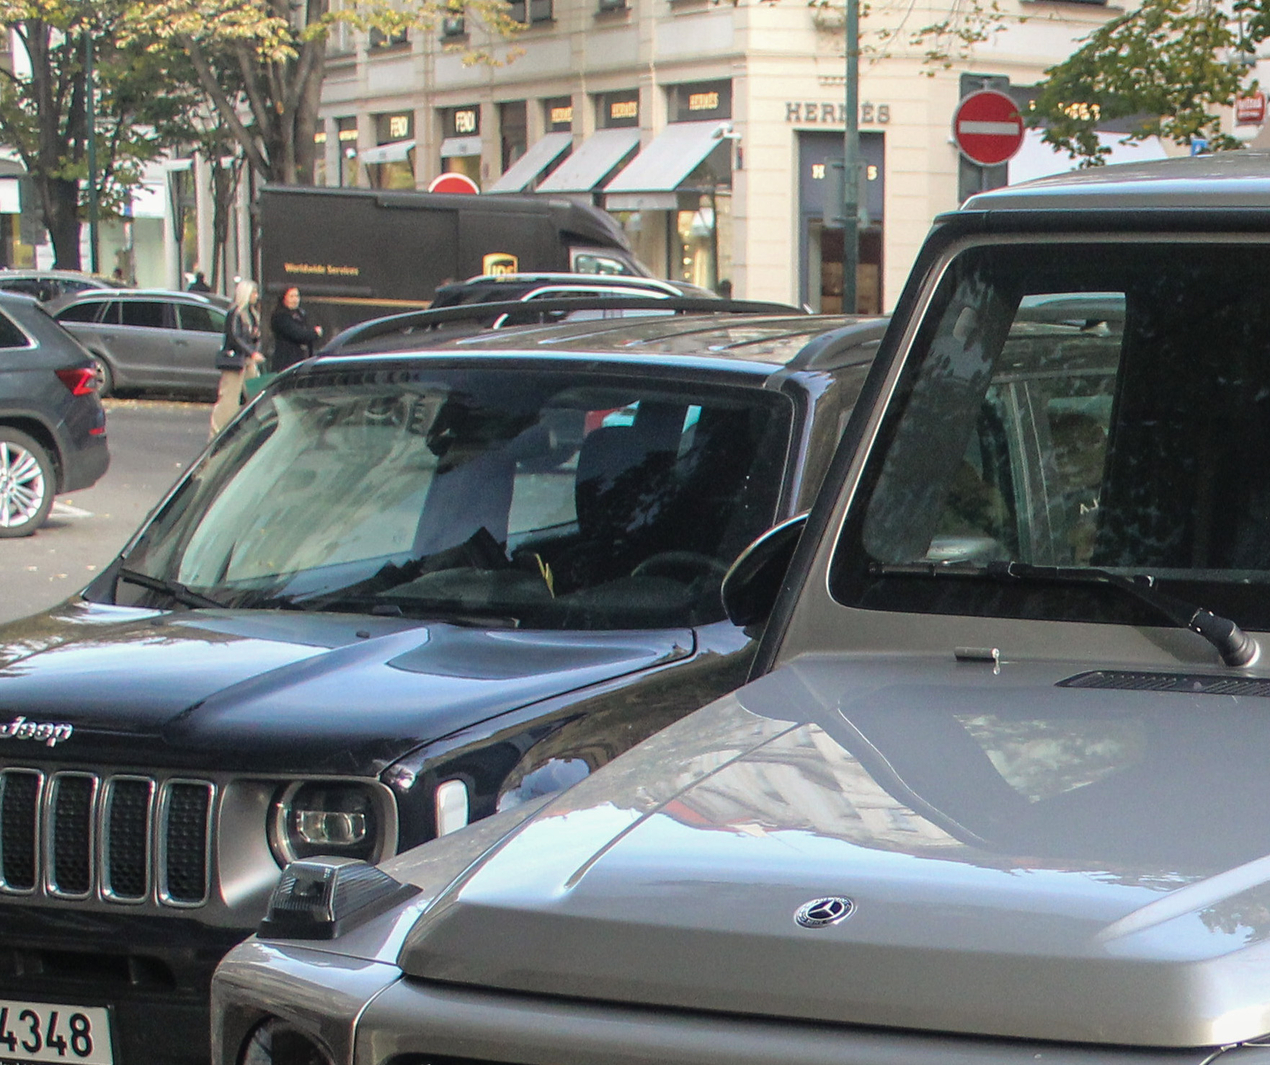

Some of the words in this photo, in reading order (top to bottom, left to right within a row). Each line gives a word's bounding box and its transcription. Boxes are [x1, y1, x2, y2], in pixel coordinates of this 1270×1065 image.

[284, 262, 325, 275] Worldwide
[327, 264, 359, 276] Services
[0, 715, 74, 748] Jeep
[0, 1007, 93, 1058] 4348
